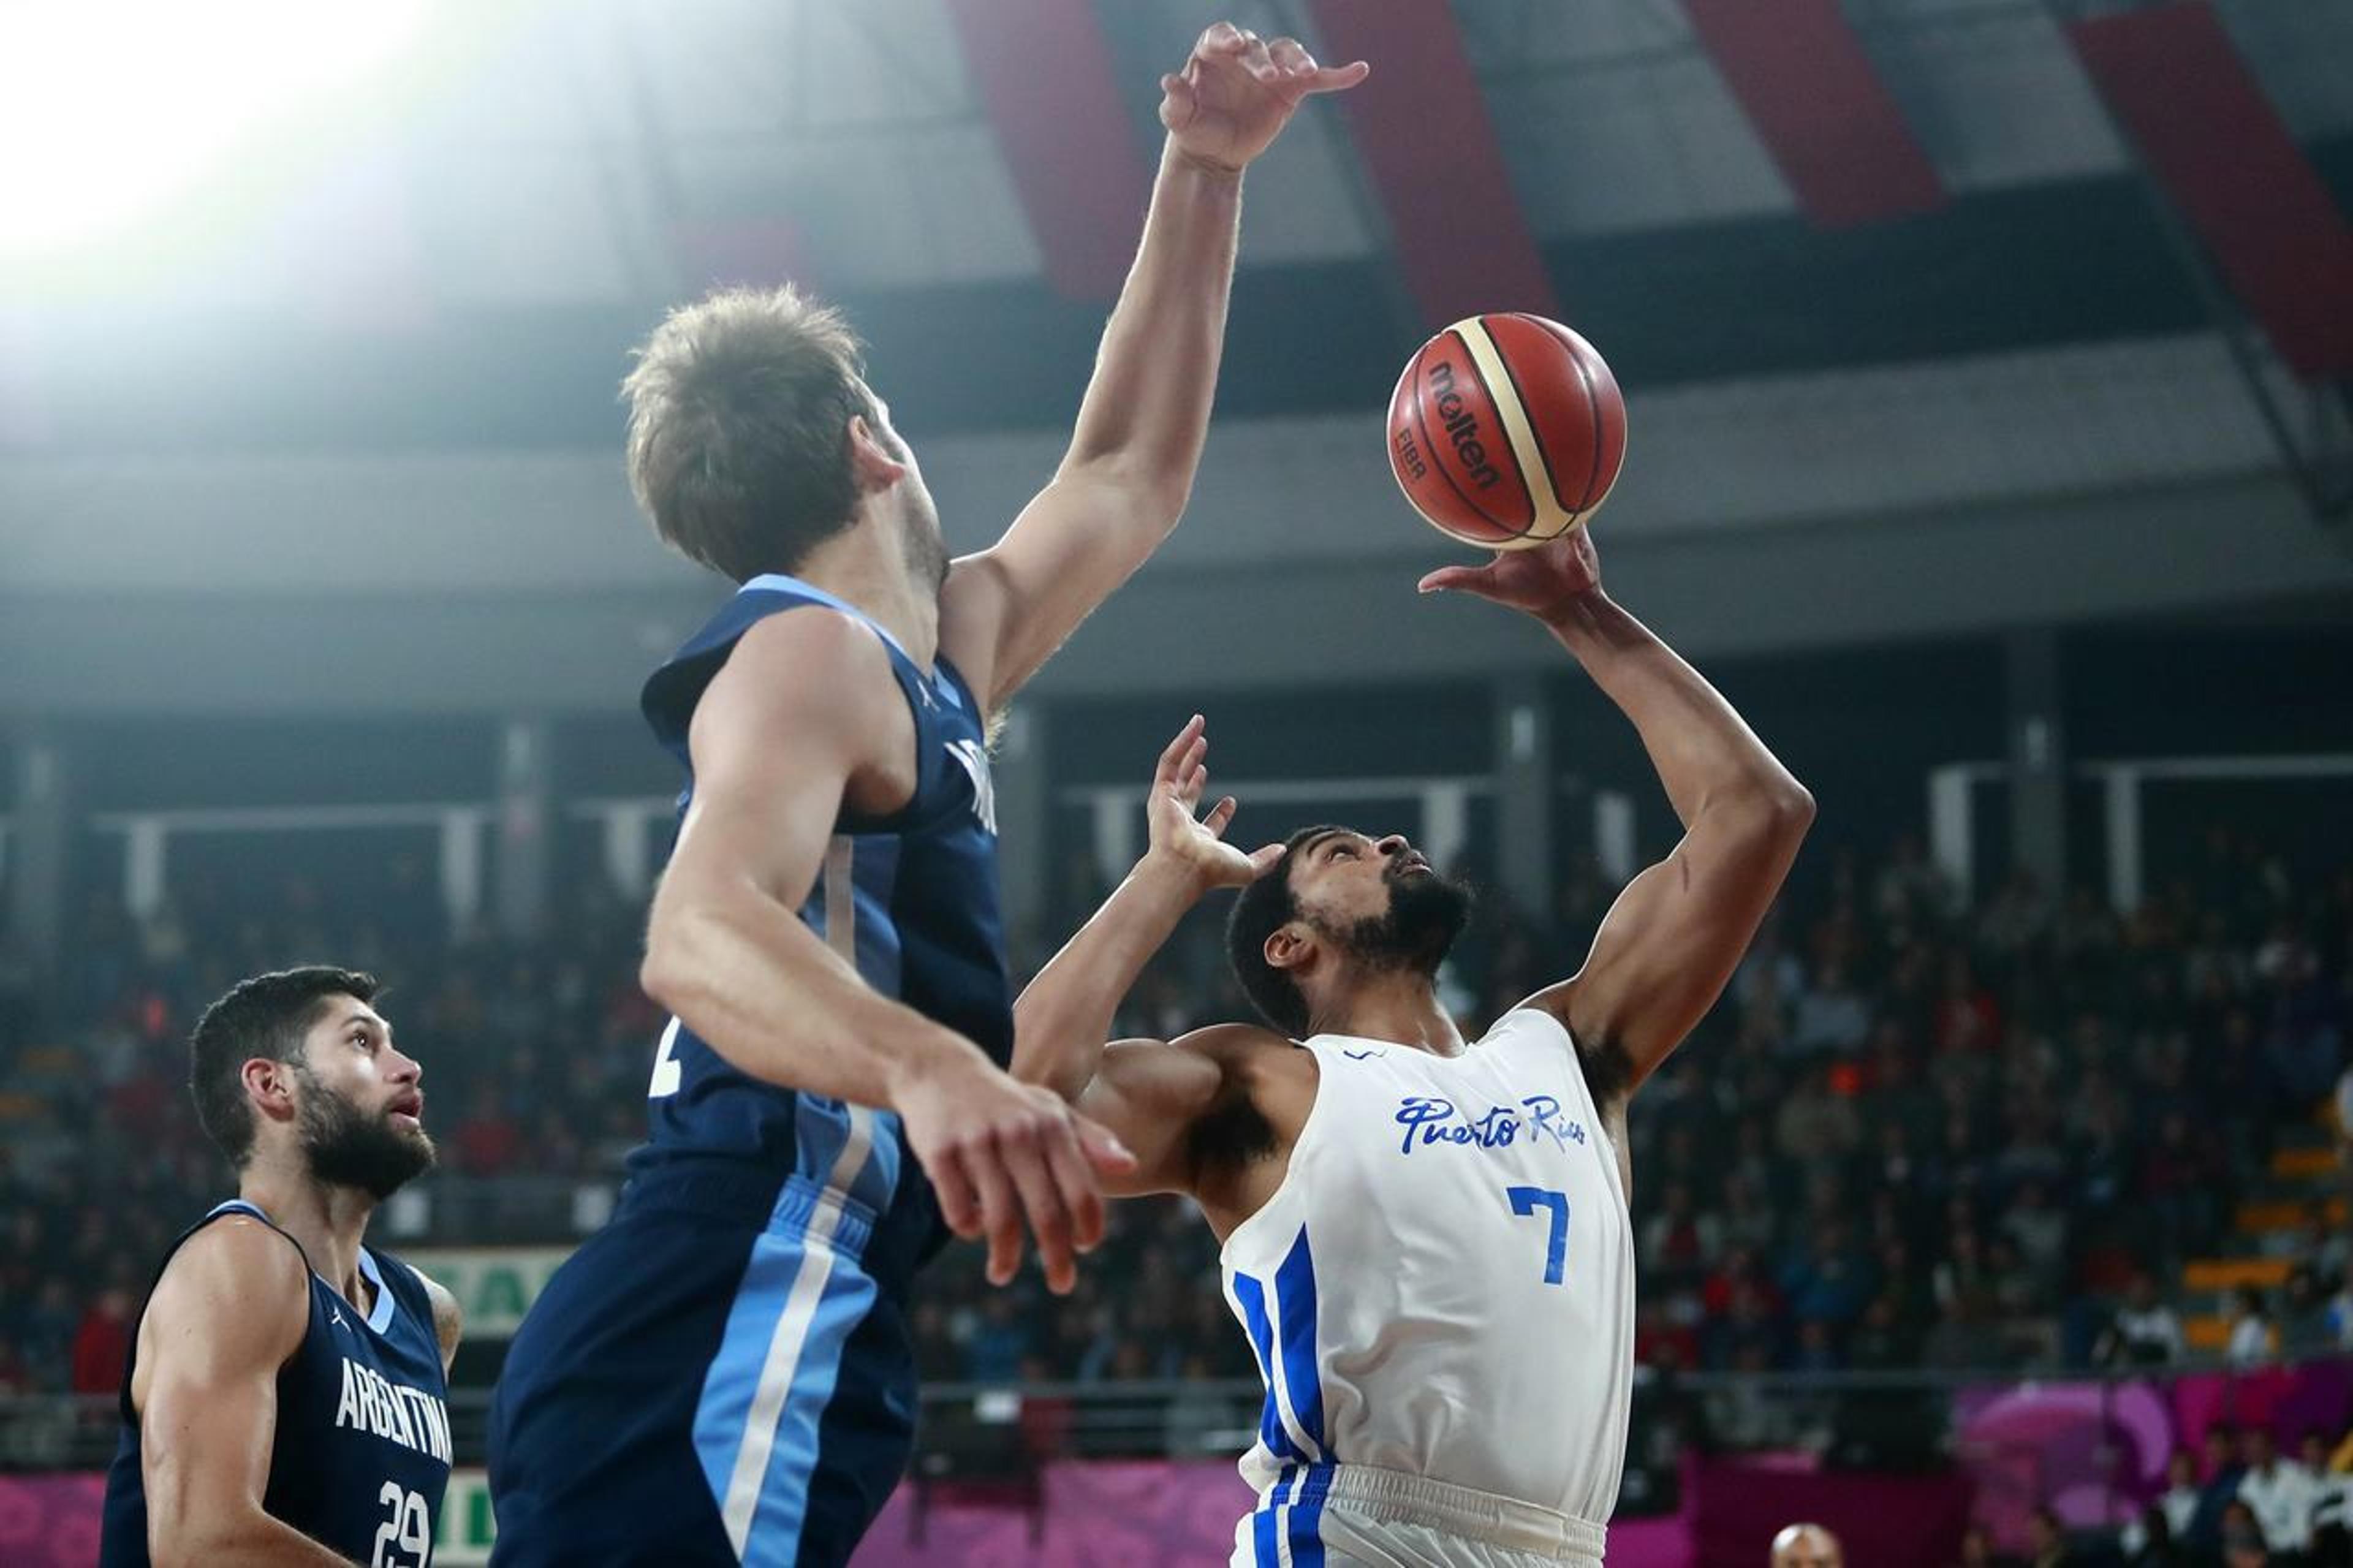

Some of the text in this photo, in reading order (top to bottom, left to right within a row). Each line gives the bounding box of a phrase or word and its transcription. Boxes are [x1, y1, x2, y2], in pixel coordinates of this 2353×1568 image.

[1398, 427, 1427, 479] FIBA
[1429, 361, 1501, 488] molten
[1395, 1096, 1521, 1154] Puerto
[1506, 1186, 1571, 1285] 7
[335, 1356, 453, 1468] ARGENTIN
[371, 1480, 431, 1568] 29
